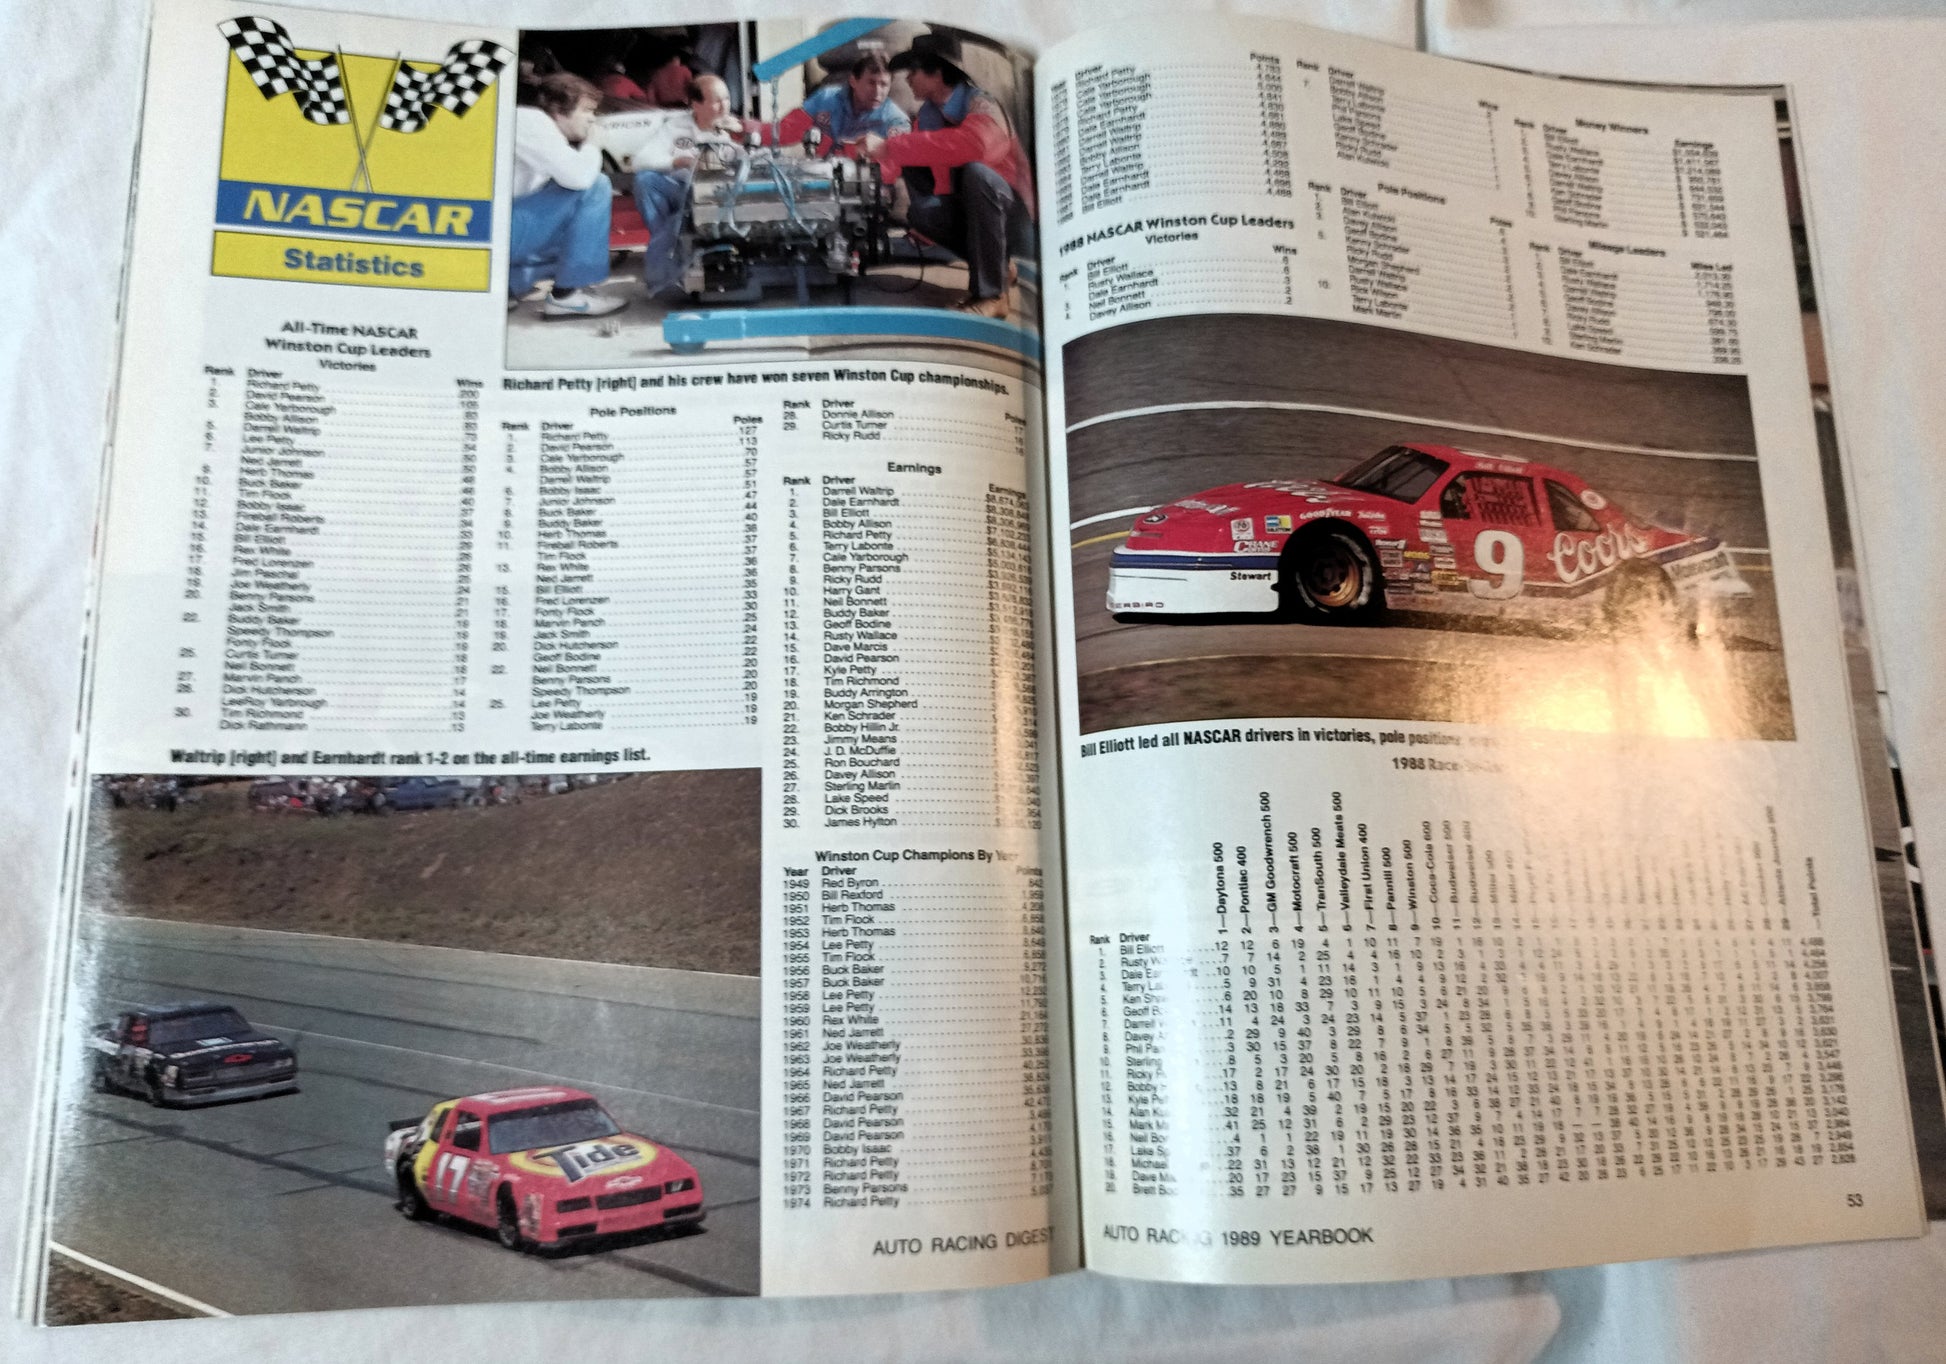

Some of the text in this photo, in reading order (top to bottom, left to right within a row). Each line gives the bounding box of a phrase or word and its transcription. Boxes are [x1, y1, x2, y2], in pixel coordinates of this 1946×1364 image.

[1250, 52, 1280, 64] Points
[243, 189, 474, 236] NASCAR
[1087, 222, 1144, 244] NASCAR
[1146, 216, 1207, 230] Winston
[1210, 214, 1238, 228] Cup
[1241, 214, 1294, 230] Leaders
[1146, 231, 1199, 244] Victories
[1272, 244, 1297, 255] Wins
[284, 248, 424, 278] Statistics
[282, 321, 419, 340] All-Time NASCAR
[265, 337, 431, 358] Winston Cup Leaders
[319, 358, 377, 372] Victories
[503, 369, 1008, 395] Richard Petty [right] and his crew have won seven Winston Cup championships.
[783, 400, 854, 409] Rank Driver
[590, 405, 676, 417] Pole Positions
[823, 411, 894, 419] Donnie Allison
[734, 415, 763, 424] Poles
[823, 421, 887, 430] Curtis Turner
[541, 421, 573, 431] Driver
[823, 432, 880, 442] Ricky Rudd
[888, 462, 942, 475] Earnings
[783, 476, 855, 485] Rank Driver
[823, 487, 894, 498] Darrell Waltrip
[823, 498, 900, 507] Dale Earnhardt
[823, 509, 870, 518] Bill Elliott
[823, 520, 892, 530] Bobby Allison
[823, 531, 892, 541] Richard Petty
[823, 542, 894, 553] Terry Labonte
[1547, 522, 1647, 584] Coors
[823, 553, 909, 564] Cale Yarborough
[1467, 530, 1525, 600] 9
[1230, 572, 1272, 581] Stewart
[823, 609, 889, 620] Buddy Baker
[823, 620, 892, 630] Geoff Bodine
[823, 632, 898, 642] Rusty Wallace
[823, 654, 900, 663] David Pearson
[823, 666, 877, 676] Kyle Petty
[824, 700, 918, 710] Morgan Shepherd
[824, 711, 896, 720] Ken Schrader
[1080, 741, 1096, 757] Bill
[1100, 737, 1134, 753] Elliott
[1138, 734, 1158, 750] led
[1162, 731, 1179, 746] all
[1184, 728, 1242, 745] NASCAR
[1245, 728, 1294, 742] drivers
[1298, 727, 1310, 741] in
[1314, 728, 1376, 746] victories,
[1380, 729, 1404, 745] pole
[171, 748, 651, 767] Waltrip [right] and Earnhardt rank 1-2 on the all-time earnings list.
[1392, 757, 1425, 770] 1988
[824, 793, 889, 805] Lake Speed
[1259, 791, 1270, 811] 500
[1332, 791, 1342, 811] 500
[1311, 827, 1321, 847] 500
[1335, 814, 1346, 848] Meats
[1358, 823, 1367, 843] 400
[1288, 832, 1298, 852] 500
[1213, 842, 1223, 862] 500
[1262, 814, 1276, 889] Goodwrench
[1403, 839, 1413, 859] 500
[815, 849, 992, 863] Winston Cup Champions By
[1236, 846, 1246, 866] 400
[1382, 847, 1392, 867] 500
[1361, 846, 1372, 880] Union
[784, 866, 857, 876] Year Driver
[822, 878, 879, 889] Red Byron
[822, 890, 883, 899] Bill Rexford
[822, 902, 896, 912] Herb Thomas
[1120, 933, 1150, 943] Driver
[533, 1143, 641, 1184] Tide
[1847, 1193, 1863, 1208] 53
[873, 1226, 1055, 1255] AUTO RACING DIGEST
[1104, 1224, 1374, 1247] AUTO RACG 1989 YEARBOOK
